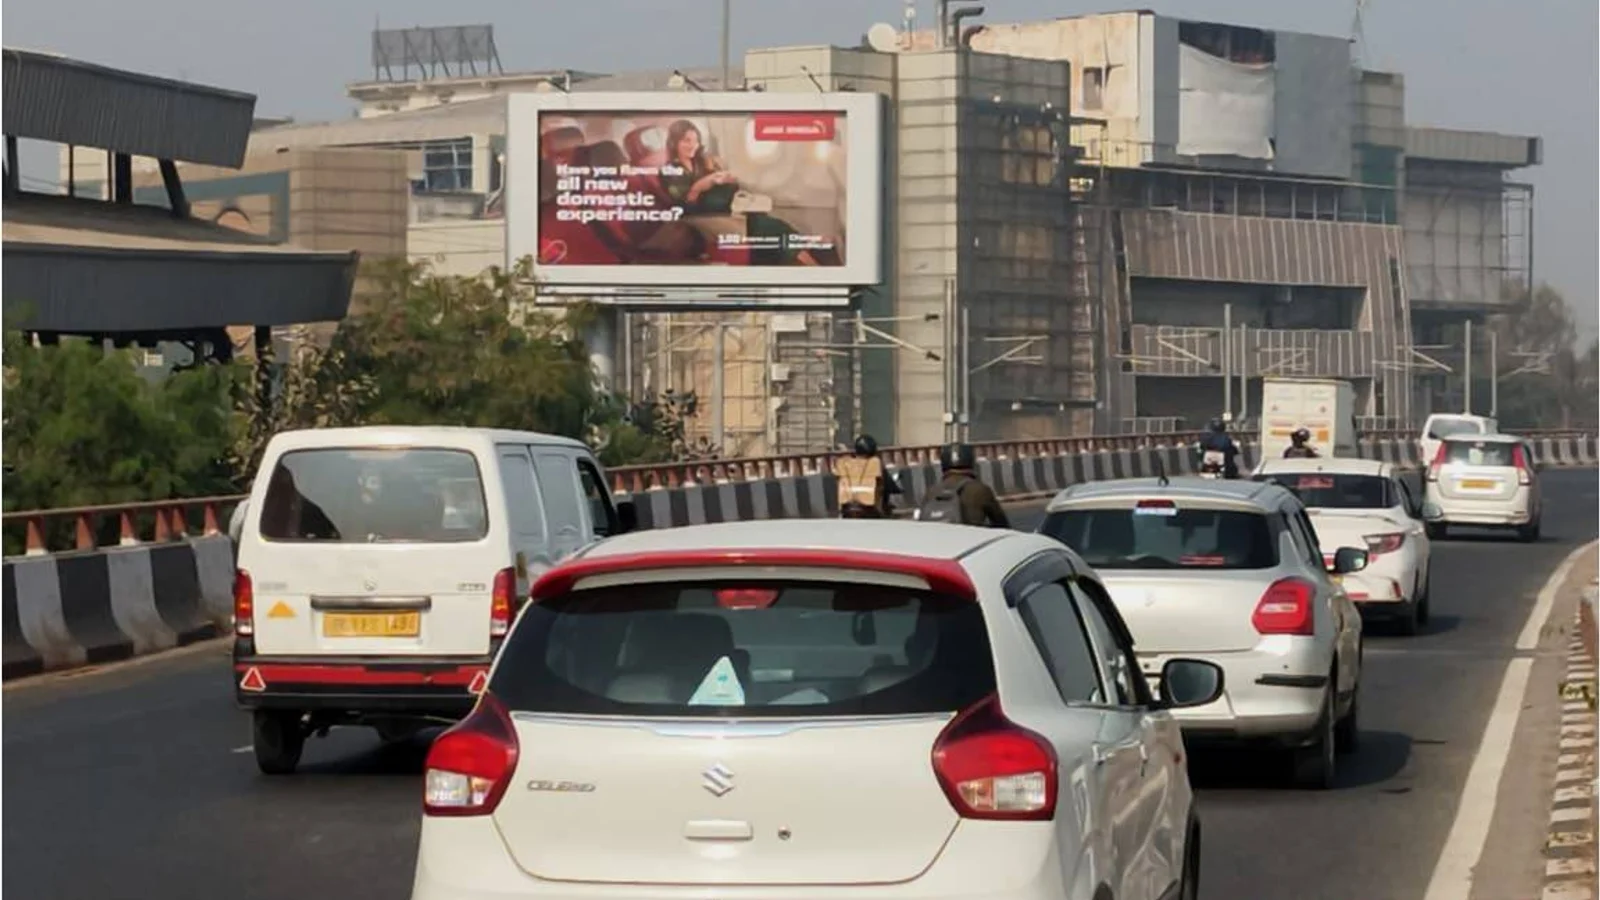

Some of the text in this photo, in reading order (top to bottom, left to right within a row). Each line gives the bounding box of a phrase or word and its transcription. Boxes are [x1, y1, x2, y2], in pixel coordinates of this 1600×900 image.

[592, 166, 617, 177] you
[661, 164, 684, 175] the
[556, 176, 629, 190] all new
[556, 191, 656, 206] domestic
[556, 207, 684, 224] experience?
